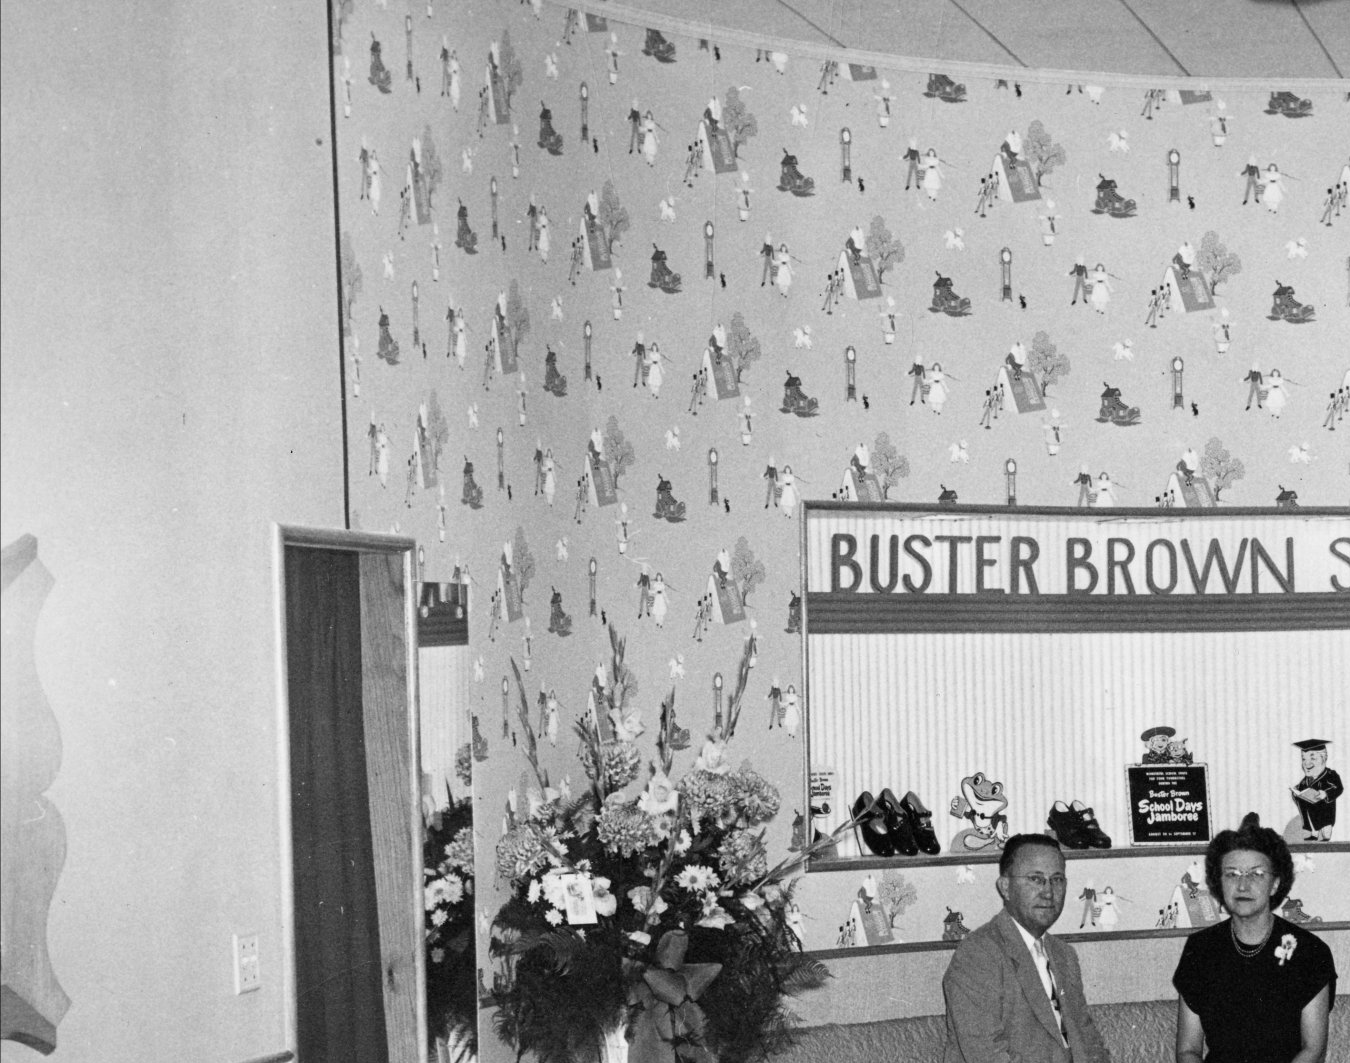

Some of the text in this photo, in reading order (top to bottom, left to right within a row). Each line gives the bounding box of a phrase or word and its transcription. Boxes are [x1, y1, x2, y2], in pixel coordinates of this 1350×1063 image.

[831, 533, 1039, 594] BUSTER
[1066, 537, 1295, 594] BROWN
[1149, 789, 1190, 798] Buster Brown
[1138, 798, 1203, 813] School Days
[1146, 811, 1199, 825] Jamboree
